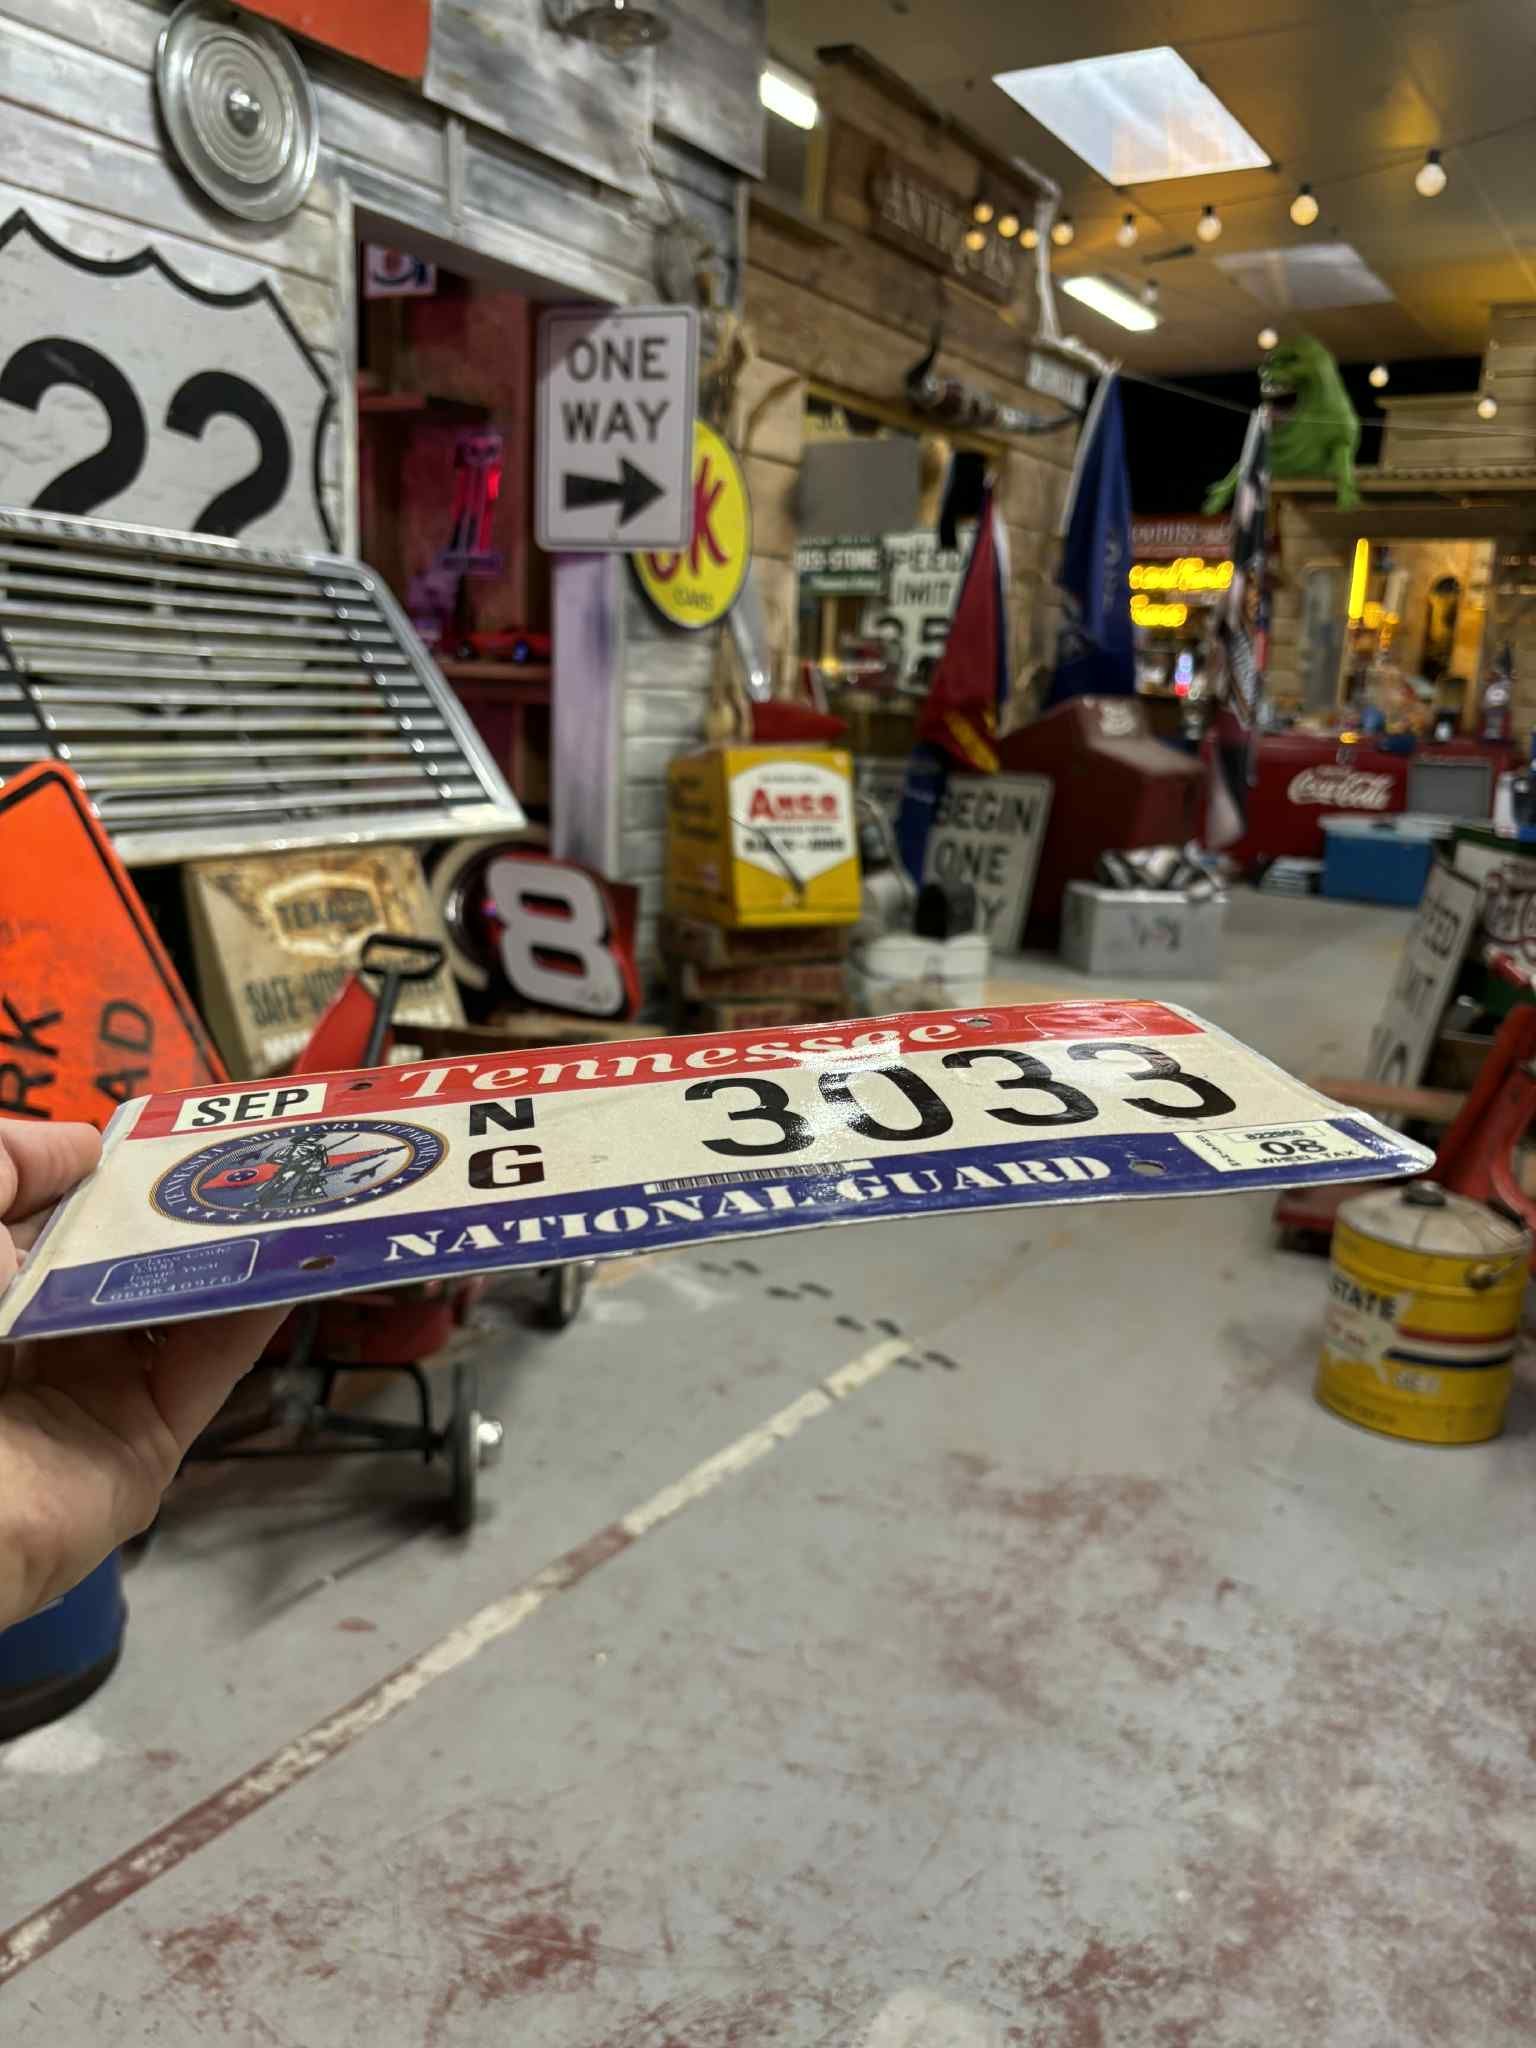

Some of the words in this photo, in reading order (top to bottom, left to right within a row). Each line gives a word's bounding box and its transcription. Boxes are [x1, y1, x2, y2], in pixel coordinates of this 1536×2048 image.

[565, 337, 668, 382] ONE
[0, 335, 292, 535] 22
[561, 401, 670, 446] WAY
[892, 582, 953, 606] IMIT
[938, 787, 1034, 834] BEGIN
[933, 839, 1008, 886] ONE
[487, 859, 624, 1017] 8
[399, 1018, 964, 1101] Tennessee
[191, 1087, 310, 1128] SEP
[684, 1042, 1237, 1157] 3033
[164, 1146, 226, 1207] TENNESSEE
[239, 1121, 360, 1145] MILITARY
[372, 1122, 439, 1173] DEPARTMENT
[1256, 1154, 1317, 1164] WHEEL
[1323, 1149, 1358, 1160] TAX
[1259, 1138, 1328, 1156] 08
[384, 1183, 816, 1262] NATIONAL
[836, 1155, 1112, 1202] GUARD
